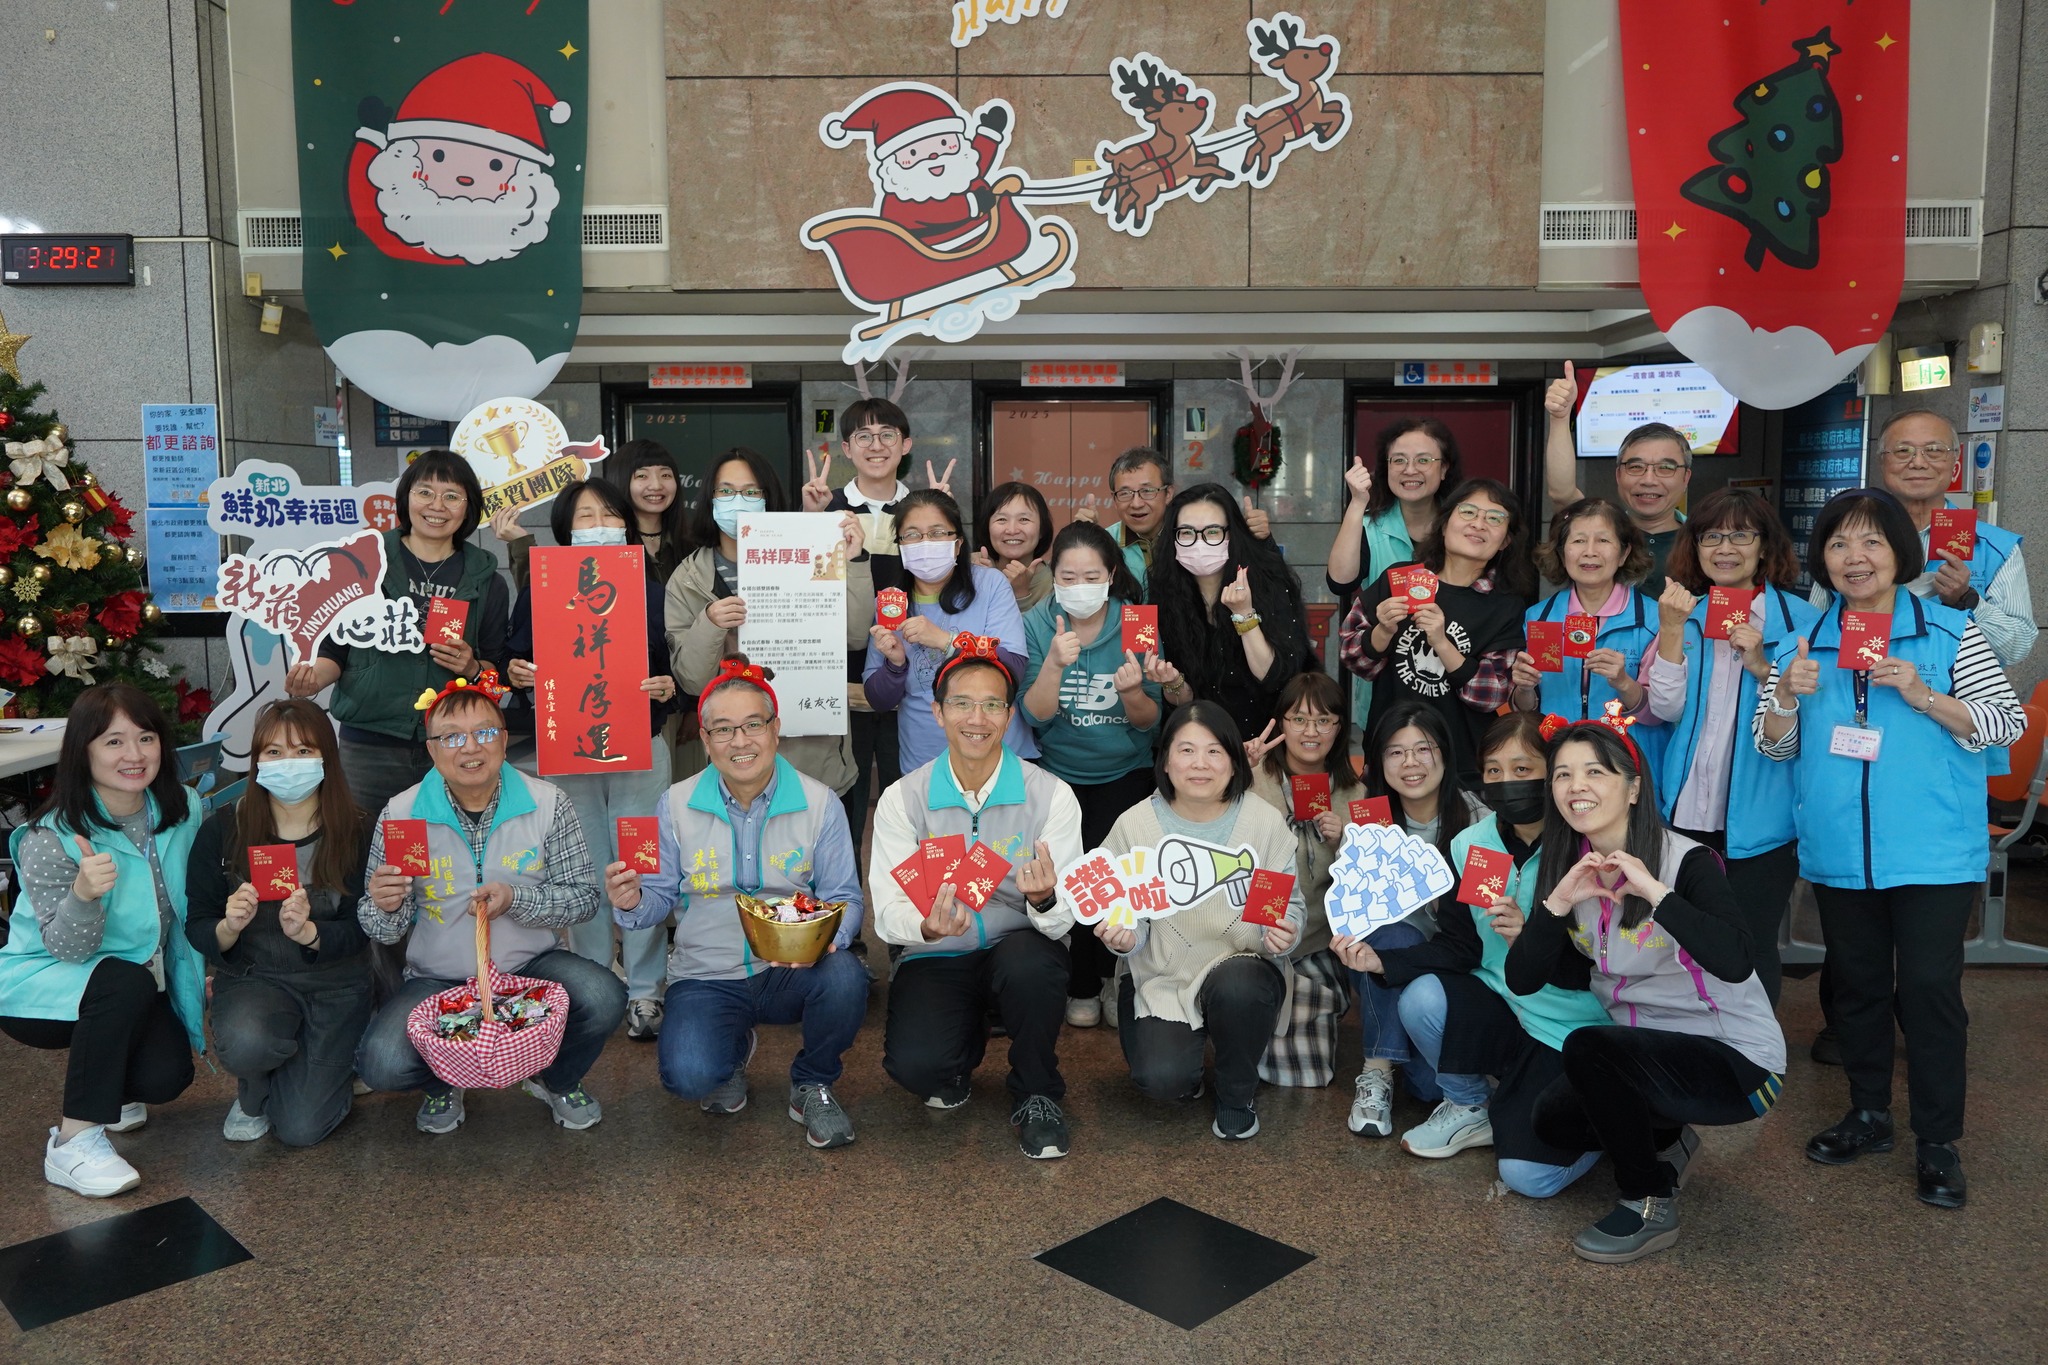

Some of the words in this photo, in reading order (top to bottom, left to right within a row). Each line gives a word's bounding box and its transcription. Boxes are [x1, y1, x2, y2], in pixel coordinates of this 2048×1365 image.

[646, 415, 687, 424] 2025
[1009, 410, 1050, 419] 2025
[146, 434, 216, 451] 都更諮詢
[1188, 441, 1204, 468] 2
[254, 477, 288, 493] 新北
[1034, 471, 1103, 487] Happy
[220, 488, 359, 527] 鮮奶幸福週
[745, 548, 811, 565] 馬祥厚運
[299, 582, 364, 642] XINZHUANG
[1395, 659, 1416, 685] THE
[1064, 855, 1172, 919] 讚啦
